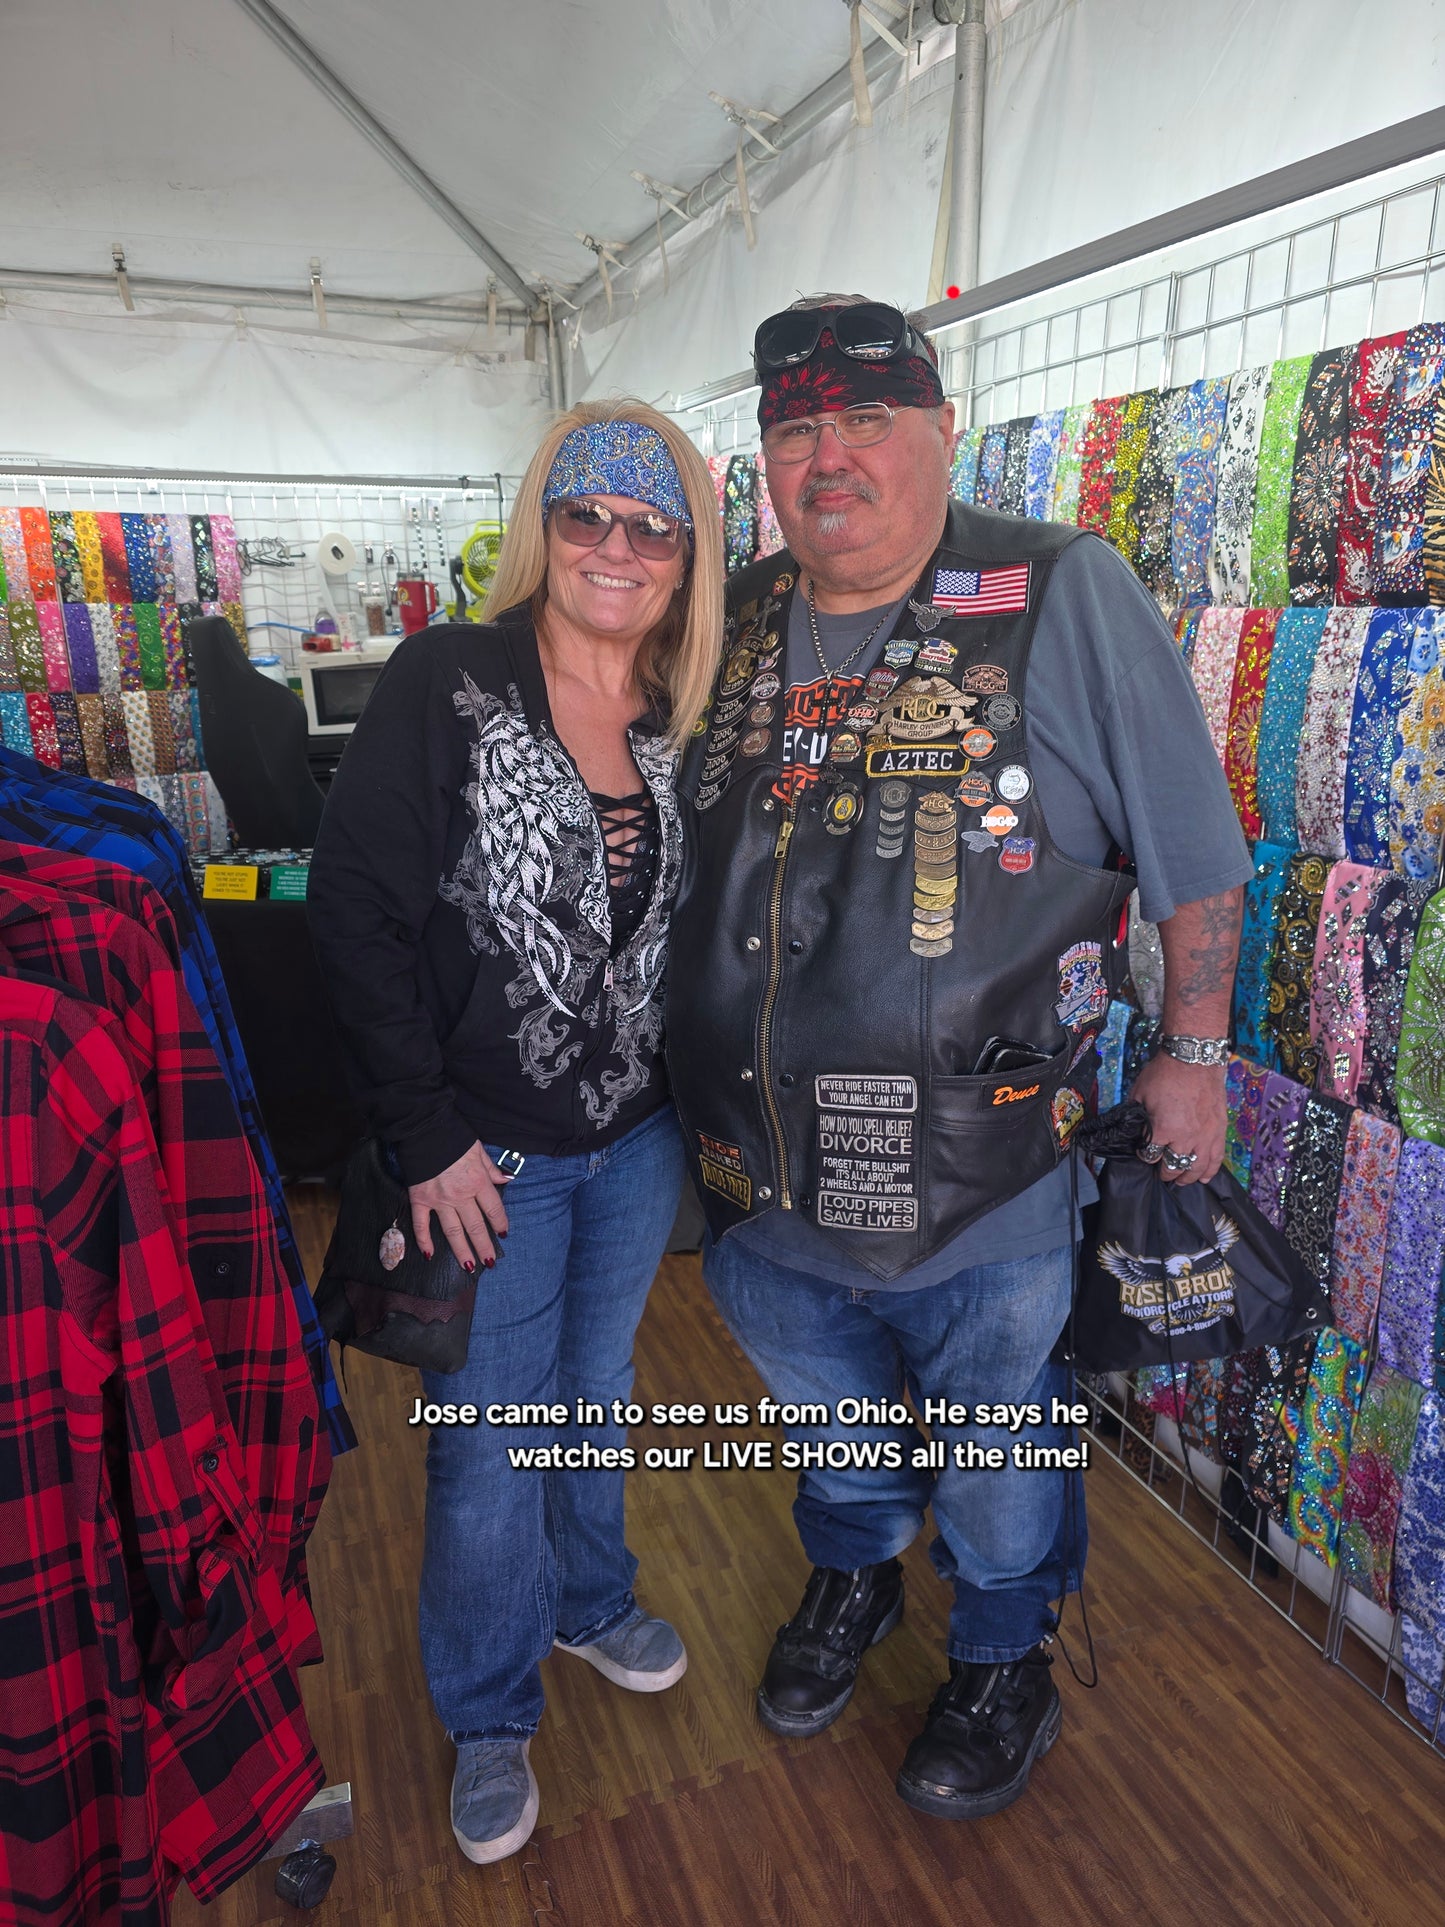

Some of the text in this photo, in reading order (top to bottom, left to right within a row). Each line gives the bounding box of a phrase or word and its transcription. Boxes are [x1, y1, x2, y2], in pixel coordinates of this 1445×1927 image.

[894, 720, 918, 729] HARLEY
[907, 730, 934, 738] GROUP
[880, 751, 954, 772] AZTEC
[820, 1080, 912, 1094] NEVER RIDE FASTER THAN
[992, 1084, 1040, 1106] Deuce
[829, 1092, 904, 1107] YOUR ANGEL CAN FLY
[820, 1114, 912, 1137] HOW DO YOU SPELL RELIEF?
[699, 1134, 740, 1160] RIDE
[820, 1133, 912, 1155] DIVORCE
[823, 1157, 910, 1174] FORGET THE BULLSHIT
[836, 1169, 894, 1183] IT'S ALL ABOUT
[820, 1178, 913, 1194] 2 WHEELS AND A MOTOR
[824, 1195, 914, 1213] LOUD PIPES
[823, 1209, 913, 1228] SAVE LIVES
